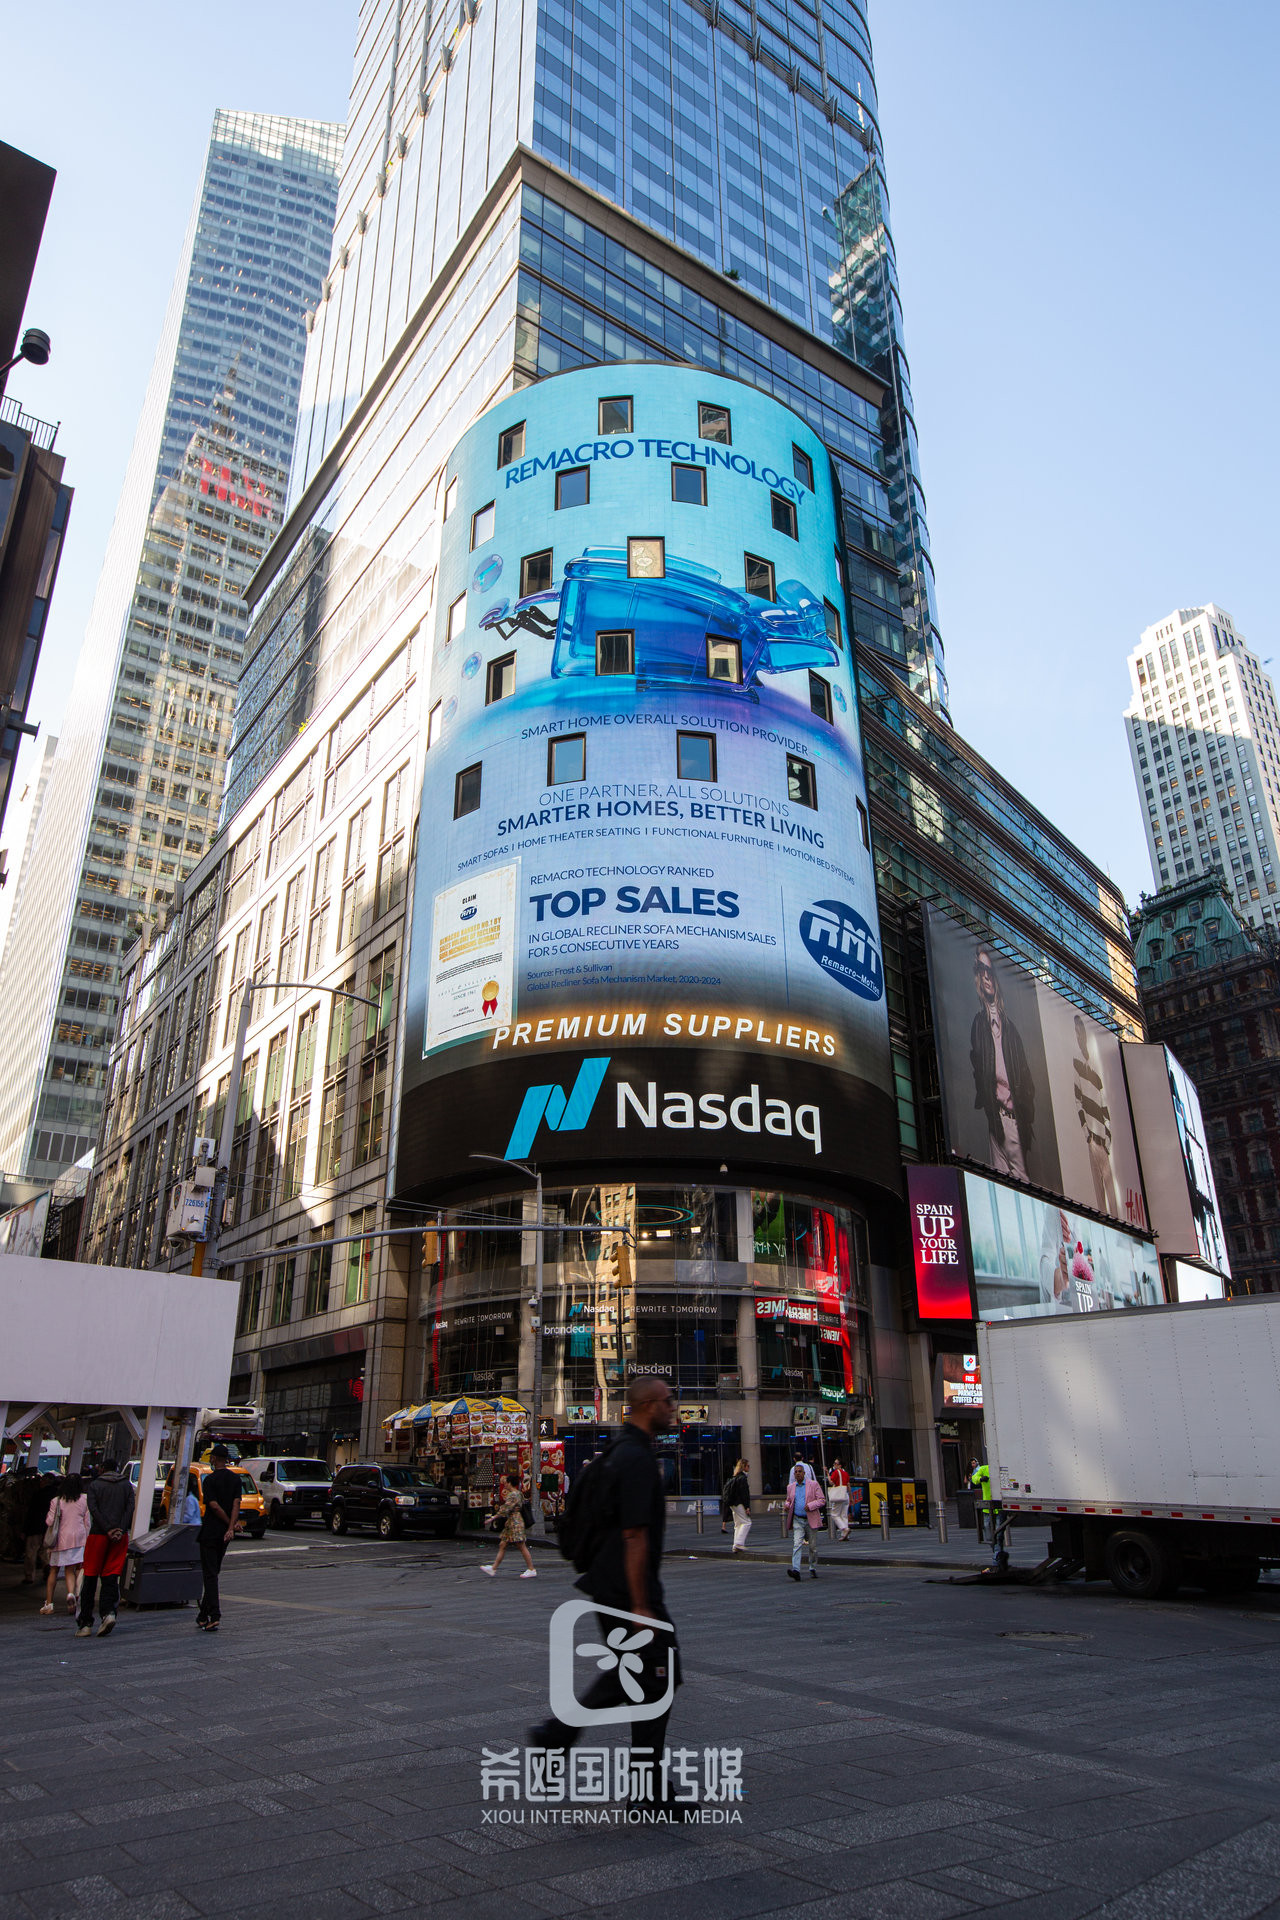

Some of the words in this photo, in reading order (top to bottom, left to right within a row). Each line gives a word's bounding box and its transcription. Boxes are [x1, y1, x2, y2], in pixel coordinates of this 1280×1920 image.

[506, 440, 634, 489] REMACRO
[638, 439, 806, 505] TECHNOLOGY
[521, 720, 565, 740] SMART
[568, 714, 611, 729] HOME
[613, 713, 678, 725] OVERALL
[680, 715, 749, 735] SOLUTION
[752, 727, 809, 756] PROVIDER
[539, 788, 575, 806] ONE
[666, 784, 697, 799] ALL
[700, 787, 790, 817] SOLUTIONS
[497, 803, 590, 837] SMARTER
[597, 800, 684, 819] HOMES,
[690, 802, 766, 829] BETTER
[770, 819, 825, 849] LIVING
[457, 854, 482, 872] SMART
[483, 844, 509, 861] SOFAS
[517, 836, 547, 850] HOME
[549, 829, 594, 843] THEATER
[596, 826, 641, 837] SEATING
[652, 827, 720, 840] FUNCTIONAL
[721, 832, 774, 850] FURNITURE
[783, 846, 816, 863] MOTION
[816, 857, 831, 871] BED
[831, 863, 855, 886] SYSTEMS
[530, 868, 584, 885] REMACRO
[586, 865, 666, 877] TECHNOLOGY
[667, 865, 714, 878] RANKED
[529, 887, 606, 922] TOP
[615, 885, 740, 918] SALES
[528, 933, 540, 944] IN
[541, 927, 586, 942] GLOBAL
[586, 924, 642, 936] RECLINER
[643, 924, 674, 935] SOFA
[676, 925, 746, 941] MECHANISM
[747, 931, 777, 946] SALES
[528, 945, 550, 959] FOR
[551, 945, 558, 956] 5
[559, 939, 641, 954] CONSECUTIVE
[642, 939, 680, 950] YEARS
[527, 969, 554, 980] Source:
[554, 967, 575, 976] Frost
[583, 963, 613, 973] Sullivan
[526, 981, 551, 992] Global
[551, 979, 581, 989] Recliner
[582, 975, 600, 986] Sofa
[600, 974, 647, 984] Mechanism
[492, 1013, 647, 1050] PREMIUM
[663, 1013, 836, 1056] SUPPLIERS
[616, 1081, 823, 1155] Nasdaq
[916, 1203, 954, 1216] SPAIN
[918, 1215, 955, 1238] UP
[919, 1237, 958, 1250] YOUR
[921, 1250, 959, 1266] LIFE
[1075, 1281, 1092, 1295] SPAIN
[583, 1304, 615, 1315] Nasdaq
[630, 1305, 667, 1314] REWRITE
[670, 1305, 718, 1314] TOMORROW
[1076, 1293, 1094, 1313] UP
[454, 1316, 475, 1326] REWRITE
[477, 1311, 513, 1323] TOMORROW
[627, 1362, 673, 1377] Nasdaq
